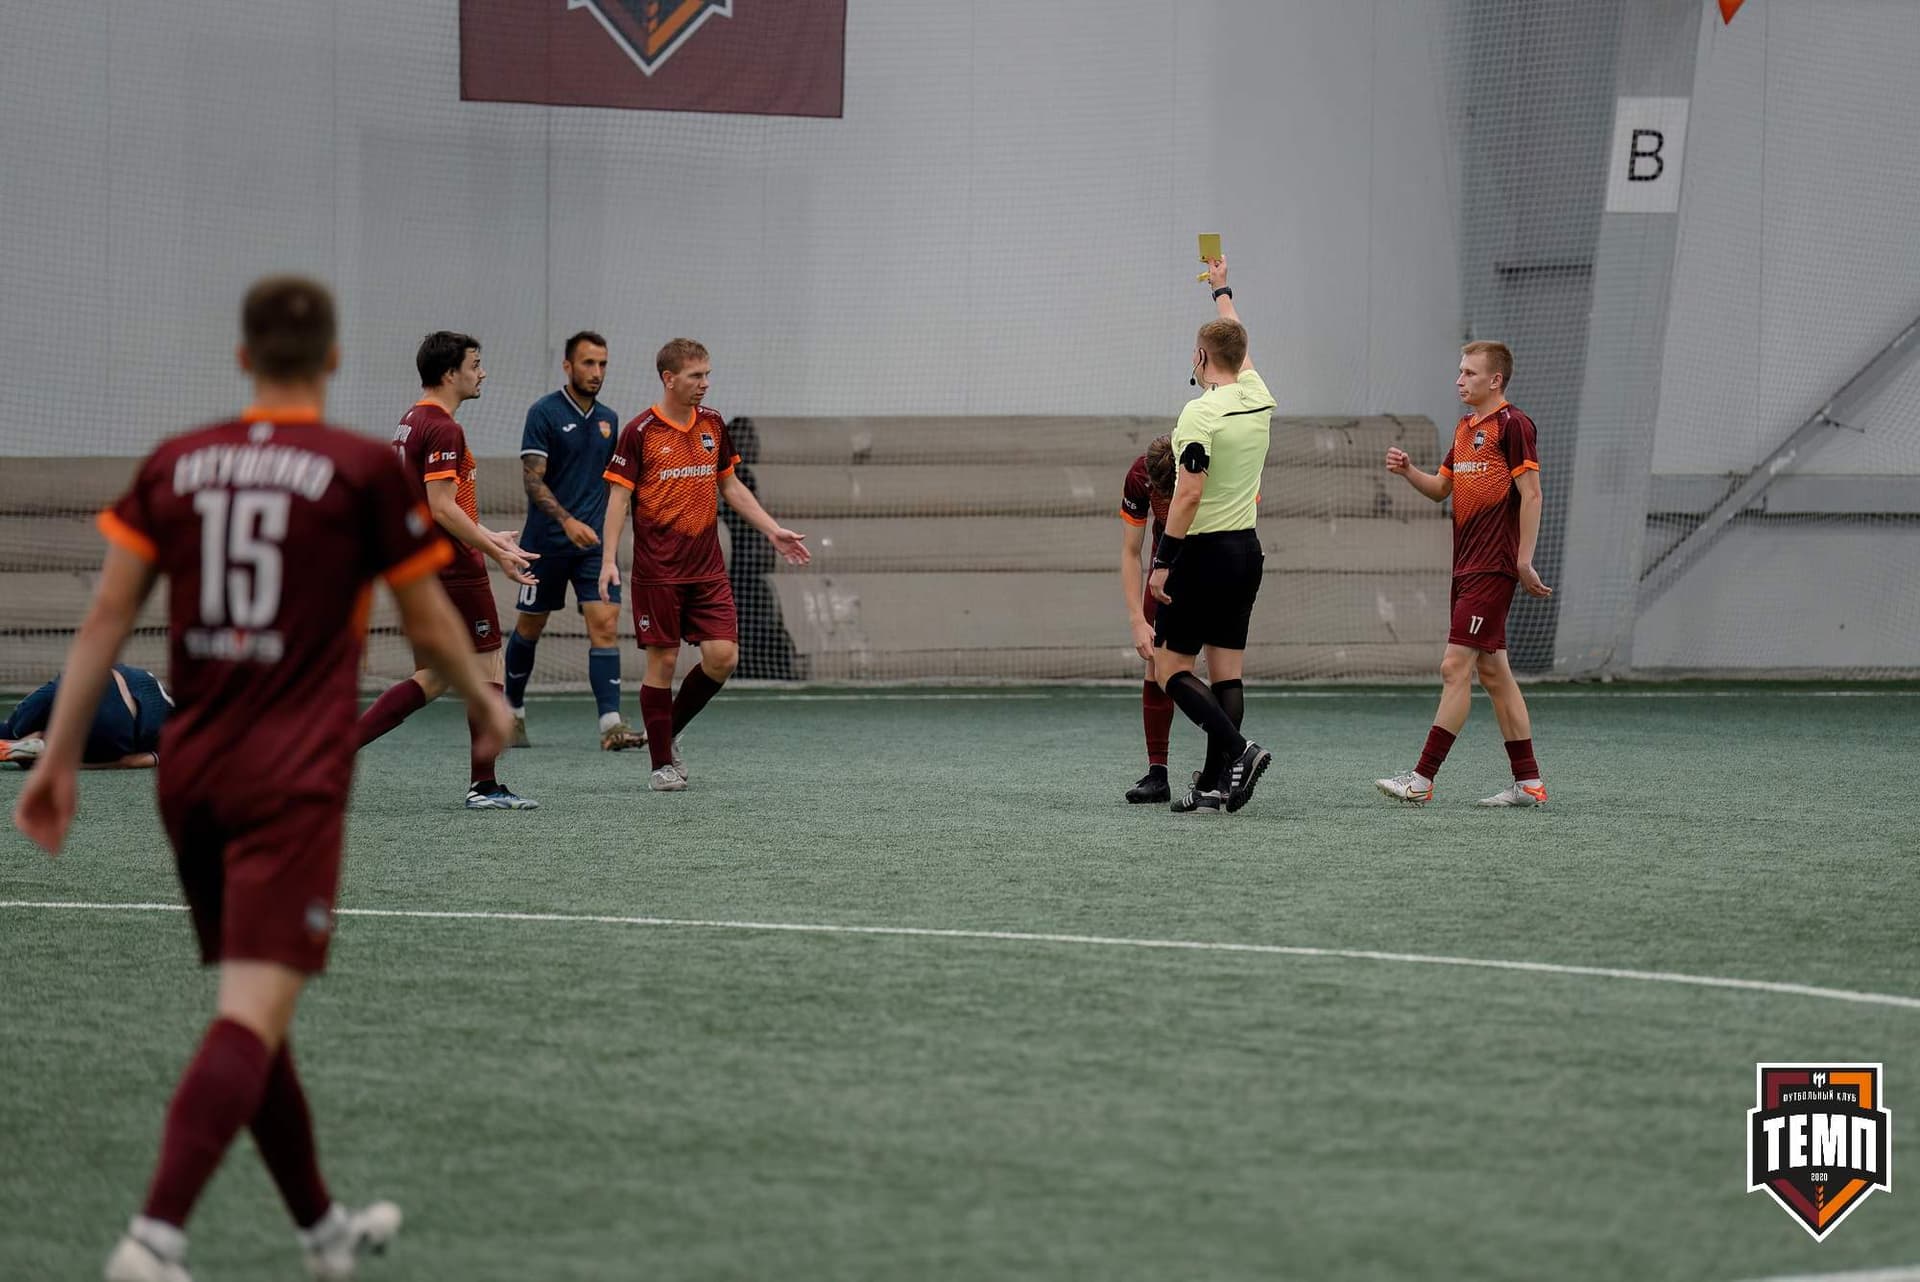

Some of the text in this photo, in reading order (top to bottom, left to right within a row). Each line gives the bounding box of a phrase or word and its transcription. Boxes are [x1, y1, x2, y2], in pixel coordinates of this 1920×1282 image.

[1628, 129, 1664, 181] B
[193, 488, 291, 628] 15
[1469, 615, 1484, 634] 17
